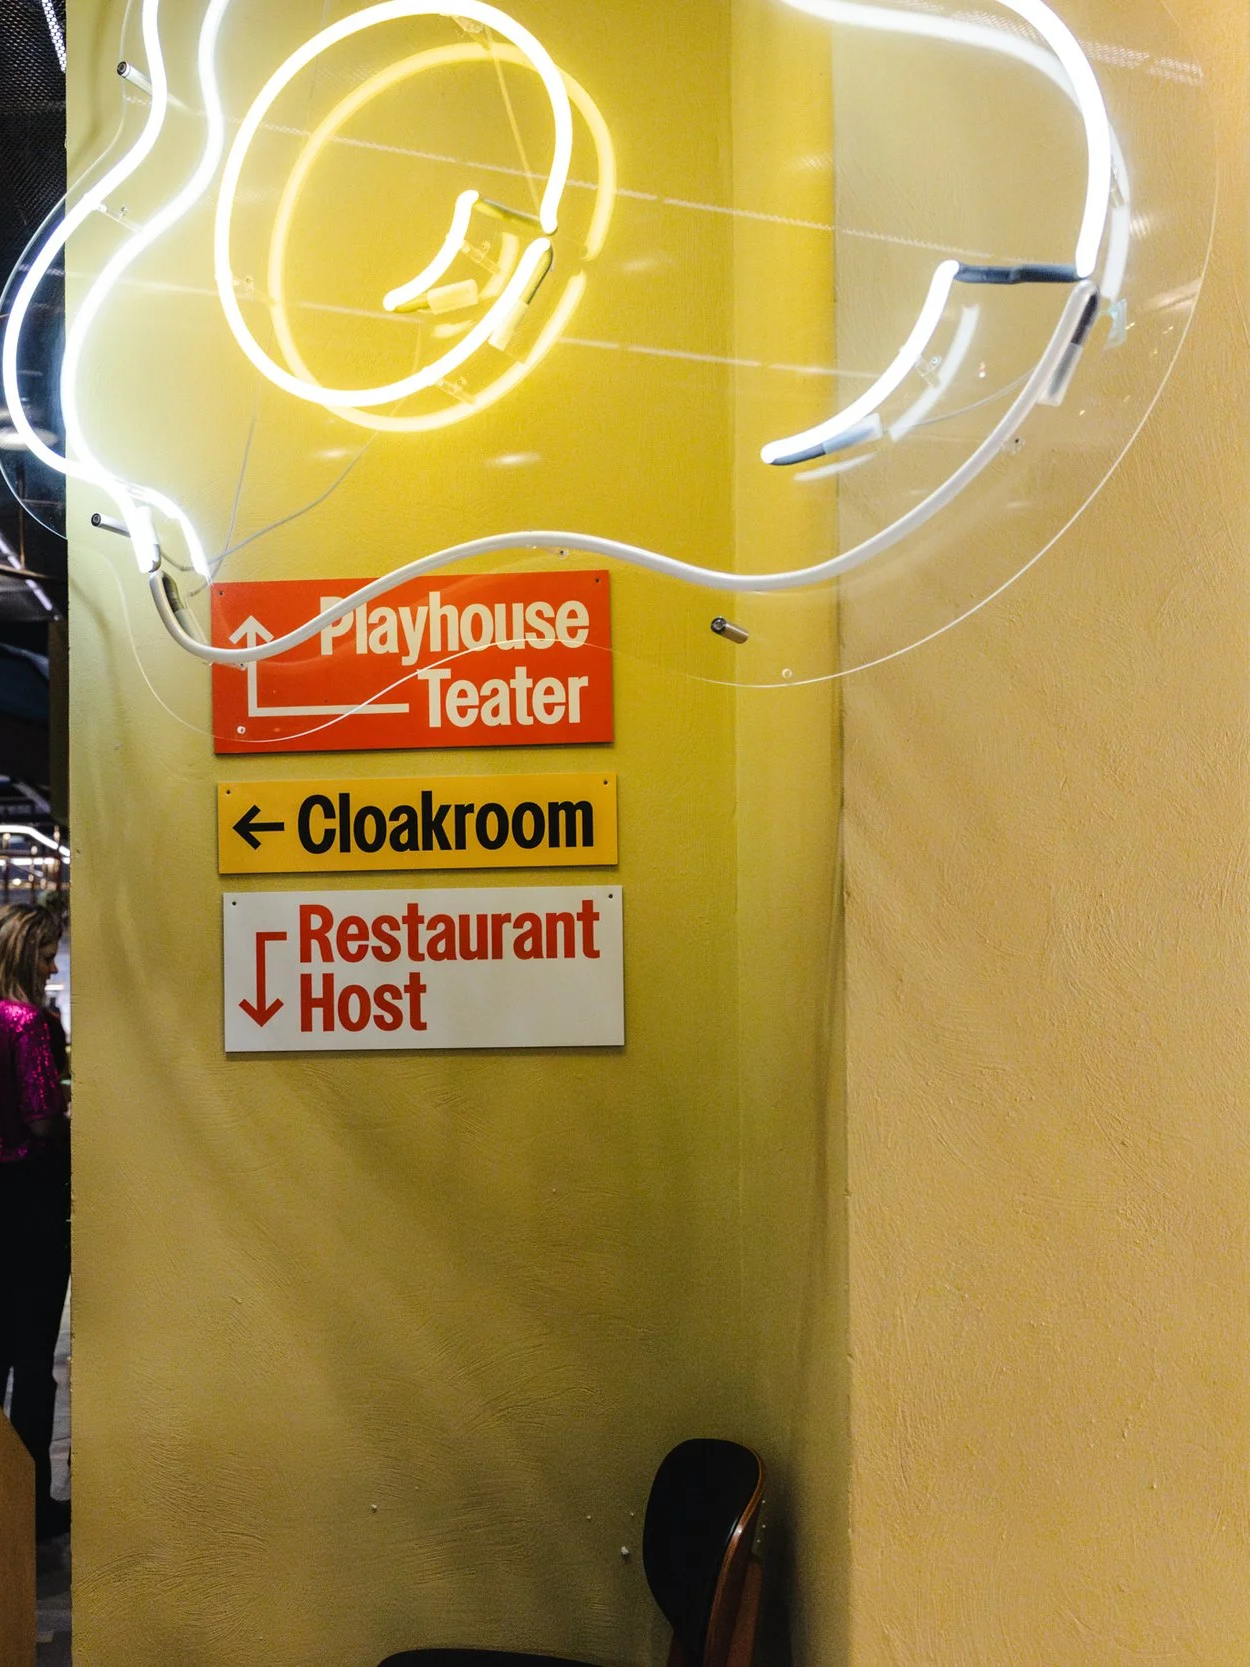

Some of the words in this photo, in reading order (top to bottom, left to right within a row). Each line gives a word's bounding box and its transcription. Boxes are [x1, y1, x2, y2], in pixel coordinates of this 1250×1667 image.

[320, 591, 590, 667] Playhouse
[417, 665, 589, 729] Teater
[297, 790, 594, 855] Cloakroom
[299, 899, 600, 964] Restaurant
[299, 971, 428, 1033] Host
